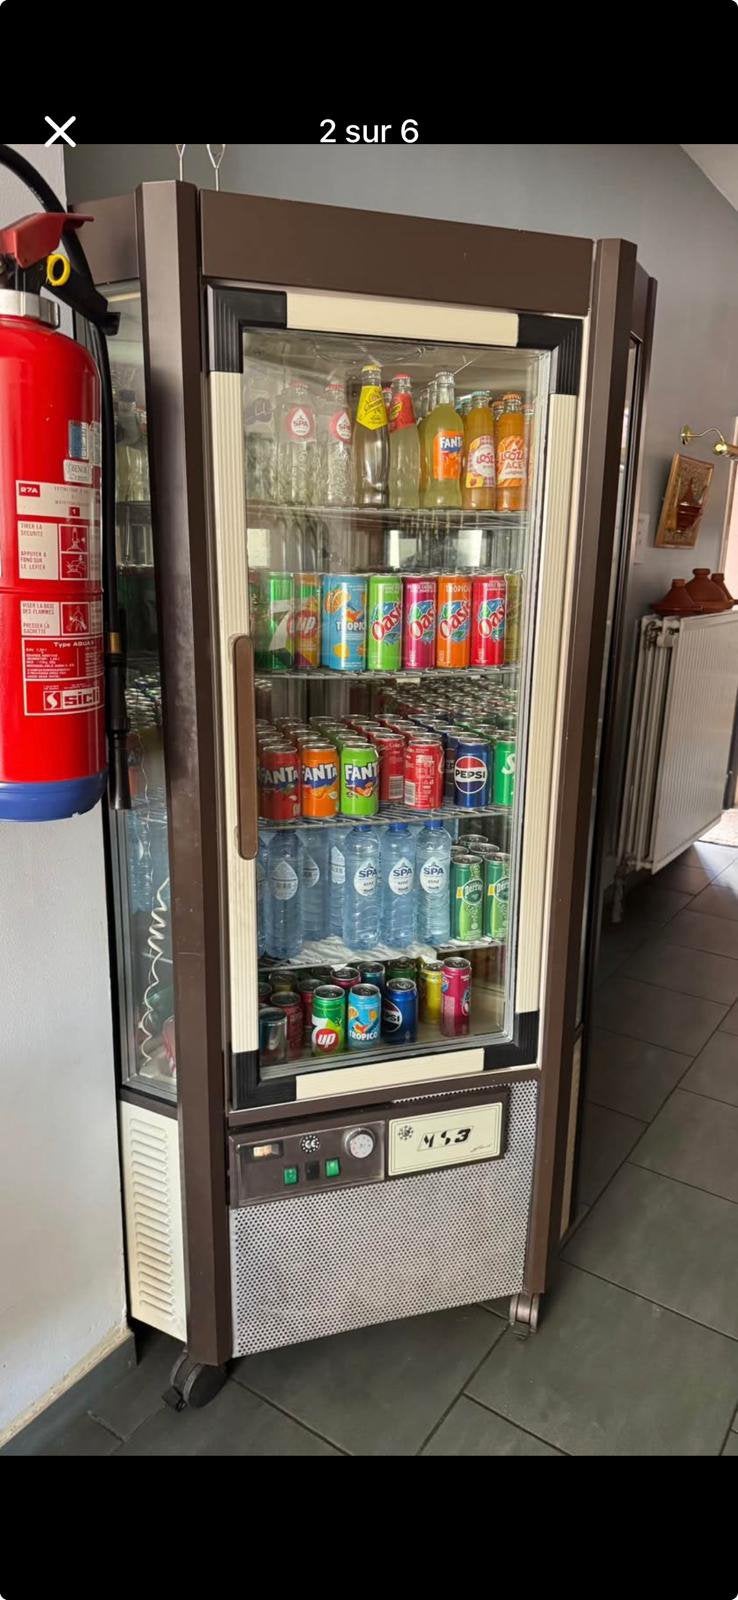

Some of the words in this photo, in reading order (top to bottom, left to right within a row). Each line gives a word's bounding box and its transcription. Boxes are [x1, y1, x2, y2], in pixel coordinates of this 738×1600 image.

[455, 768, 486, 779] PEPSI
[358, 868, 377, 878] SPA
[393, 867, 412, 877] SPA
[423, 867, 444, 875] SPA
